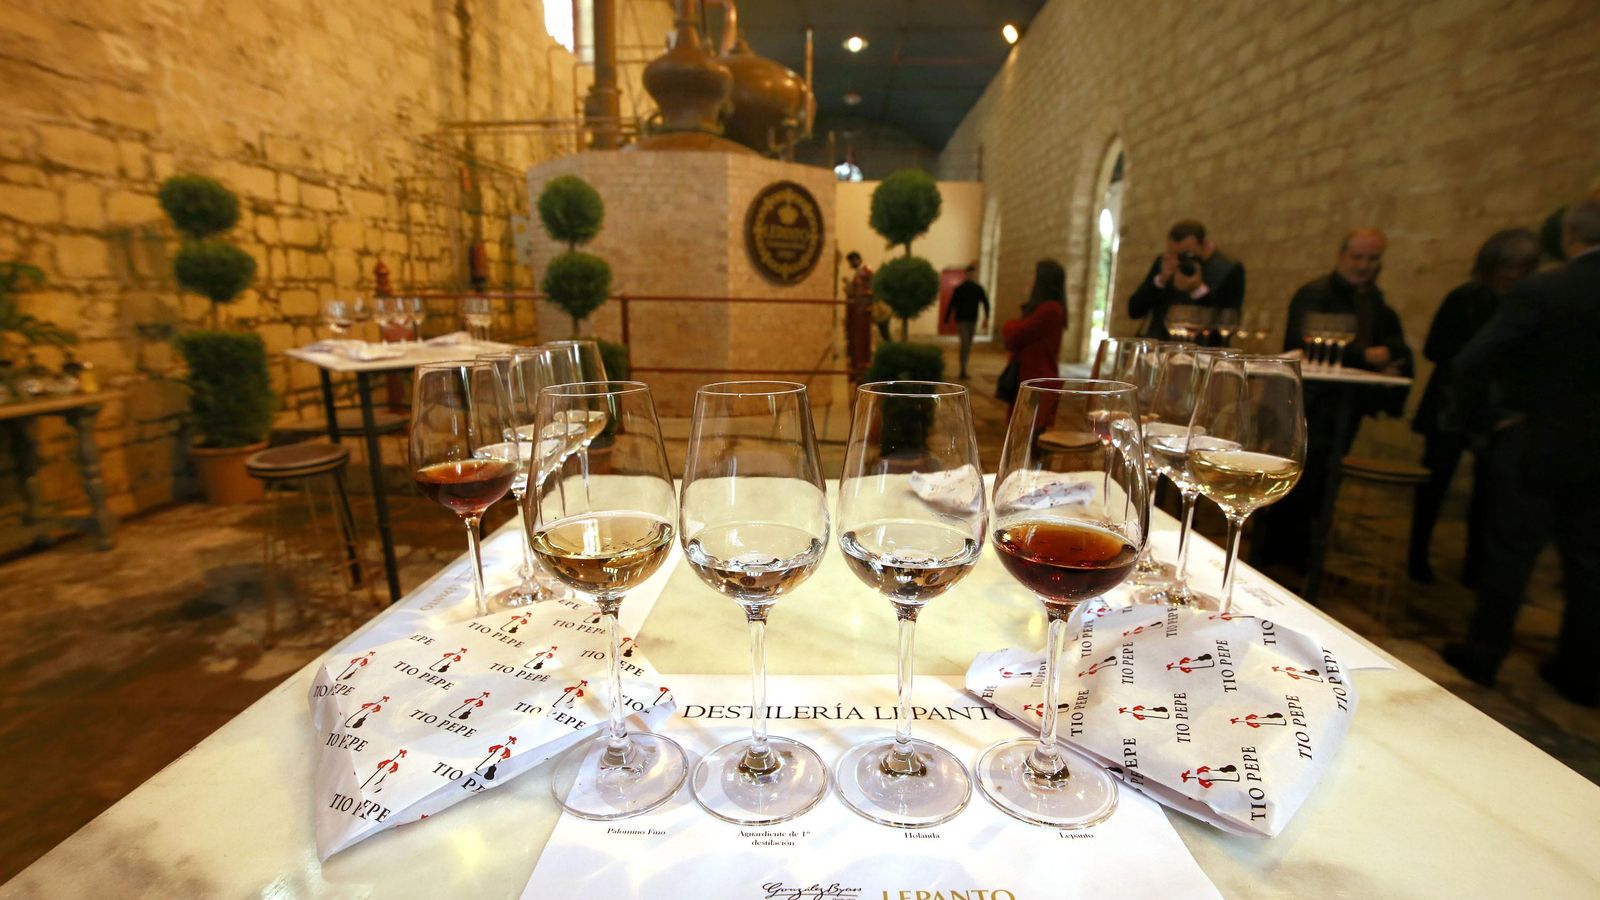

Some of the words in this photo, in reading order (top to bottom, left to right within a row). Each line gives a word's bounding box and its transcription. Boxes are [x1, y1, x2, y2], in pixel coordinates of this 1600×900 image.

[554, 599, 582, 611] EPE
[552, 619, 575, 629] TIO
[409, 634, 436, 646] EPE
[468, 622, 492, 634] TIO
[491, 631, 526, 649] PEPE
[1081, 641, 1093, 658] TIO
[1122, 641, 1134, 667] PEPE
[1215, 639, 1234, 667] PEPE
[489, 662, 515, 674] TIO
[514, 669, 552, 683] PEPE
[580, 649, 606, 661] TIO
[619, 660, 645, 677] EPE
[393, 661, 419, 676] TIO
[418, 672, 455, 691] PEPE
[1122, 669, 1134, 685] TIO
[1220, 669, 1238, 693] TIO
[622, 694, 646, 712] IO
[1073, 689, 1090, 711] PEPE
[1173, 692, 1189, 720] PEPE
[1332, 687, 1349, 713] TIO
[553, 711, 587, 731] EPE
[682, 703, 865, 720] DESTILERÍA
[1285, 694, 1307, 728] PEPE
[408, 708, 438, 724] TIO
[436, 719, 478, 738] PEPE
[1070, 711, 1084, 737] TIO
[1175, 723, 1191, 743] TIO
[1123, 737, 1139, 769] EPE
[1294, 731, 1313, 760] TIO
[431, 761, 464, 781] TIO
[1241, 746, 1263, 782] PEPE
[329, 793, 354, 812] TIO
[1248, 787, 1267, 821] TIO
[606, 827, 645, 836] Palomino
[647, 828, 667, 836] Fino
[737, 829, 787, 839] Aguardiente
[904, 831, 941, 840] Holanda
[1058, 831, 1095, 841] Lepanto
[751, 838, 795, 847] destilación
